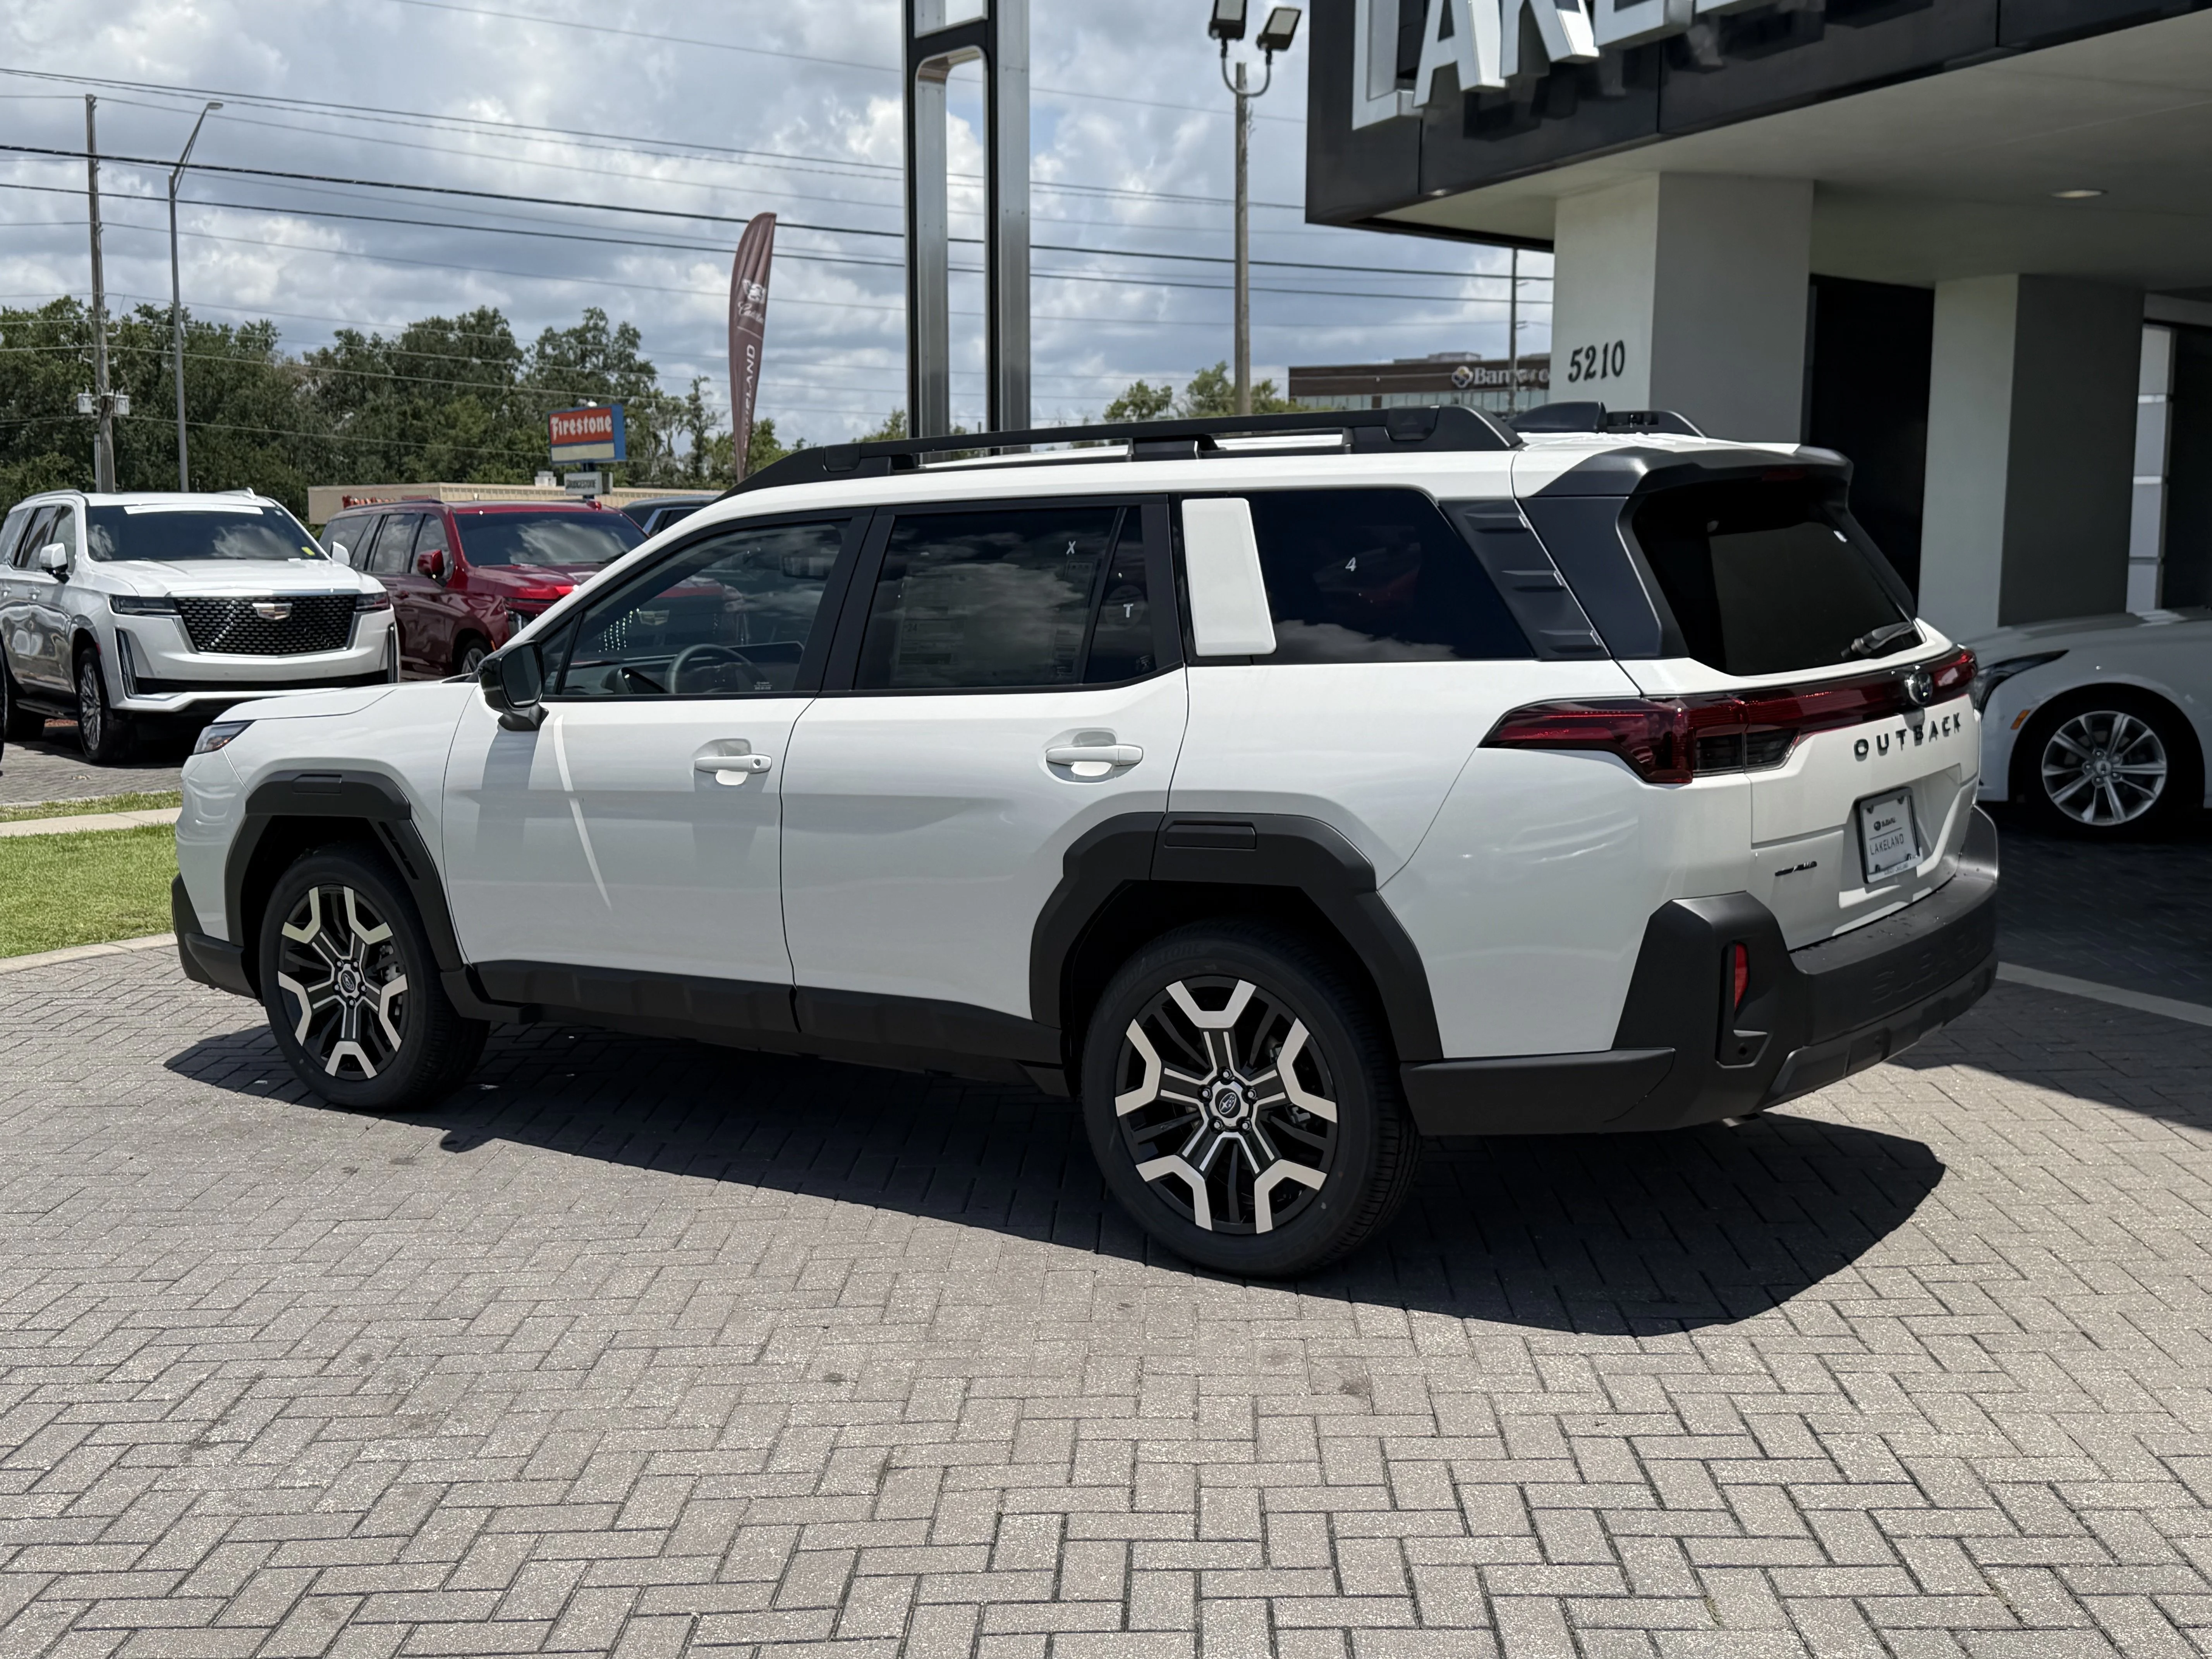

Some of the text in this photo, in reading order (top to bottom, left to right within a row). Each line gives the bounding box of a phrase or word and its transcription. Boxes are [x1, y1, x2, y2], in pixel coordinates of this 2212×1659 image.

[1568, 340, 1625, 383] 5210
[1474, 367, 1519, 385] Ban
[551, 415, 612, 440] Firestone
[1066, 541, 1076, 555] X
[1345, 557, 1357, 572] 4
[1123, 603, 1134, 618] T
[1854, 712, 1961, 756] OUTBACK
[1869, 833, 1904, 855] LAKELAND
